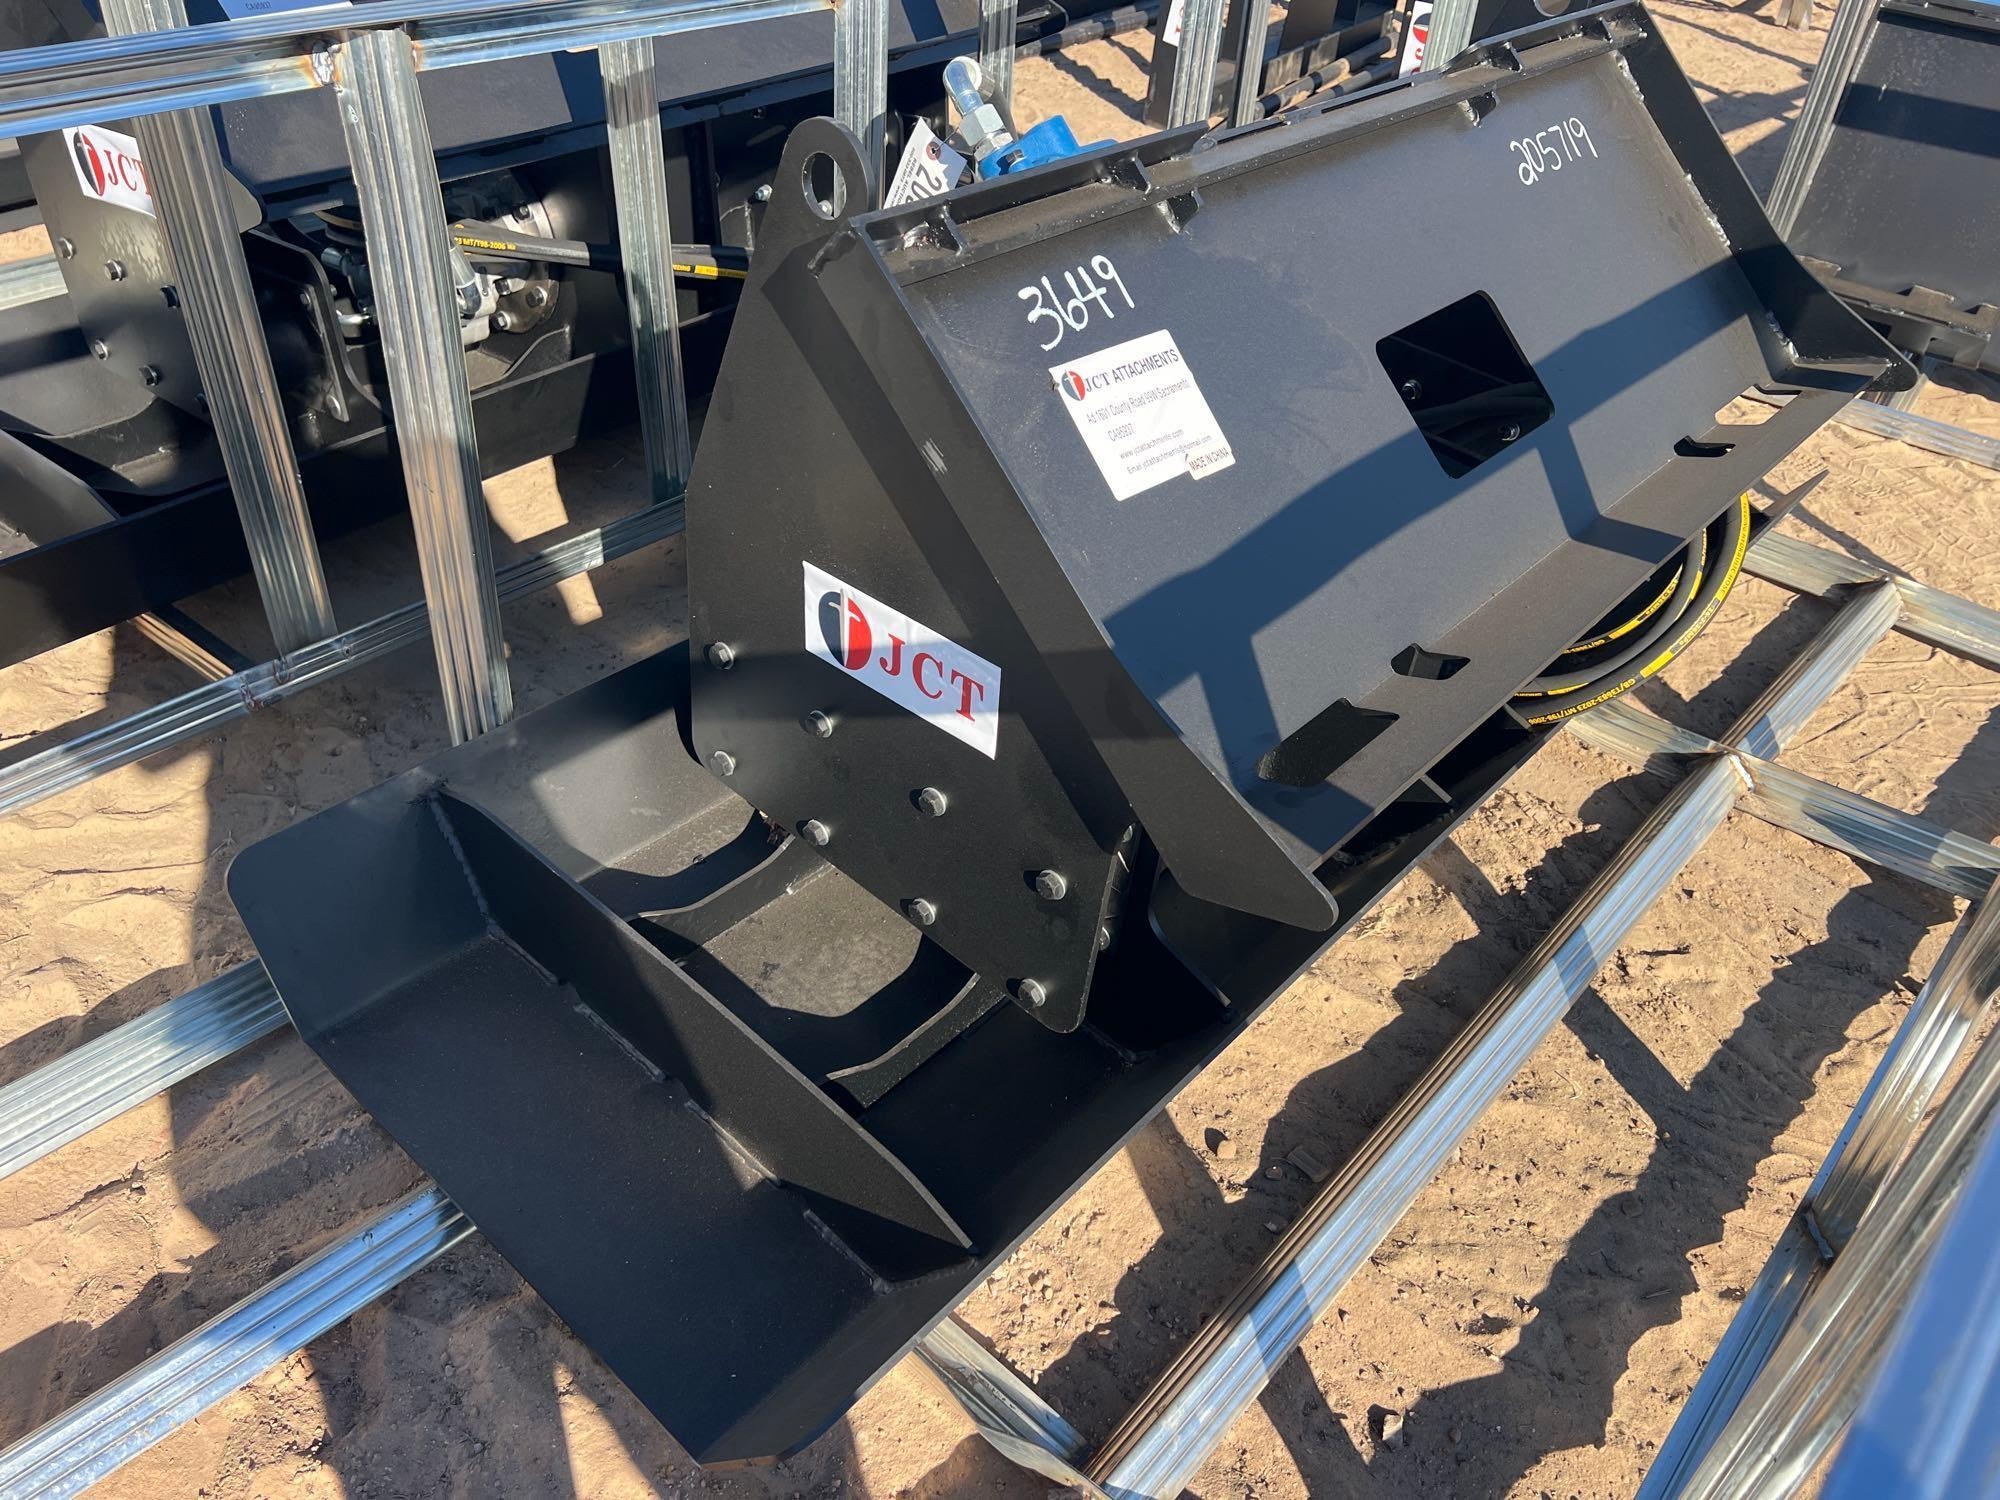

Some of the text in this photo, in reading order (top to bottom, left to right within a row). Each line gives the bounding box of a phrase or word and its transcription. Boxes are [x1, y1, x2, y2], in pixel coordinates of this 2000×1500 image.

[1510, 118, 1598, 185] 205719
[1017, 255, 1135, 351] 3649
[1085, 349, 1179, 392] JCT ATTACHMENTS
[1189, 456, 1207, 471] MADE
[1211, 446, 1231, 461] CHINA
[879, 633, 985, 723] JCT
